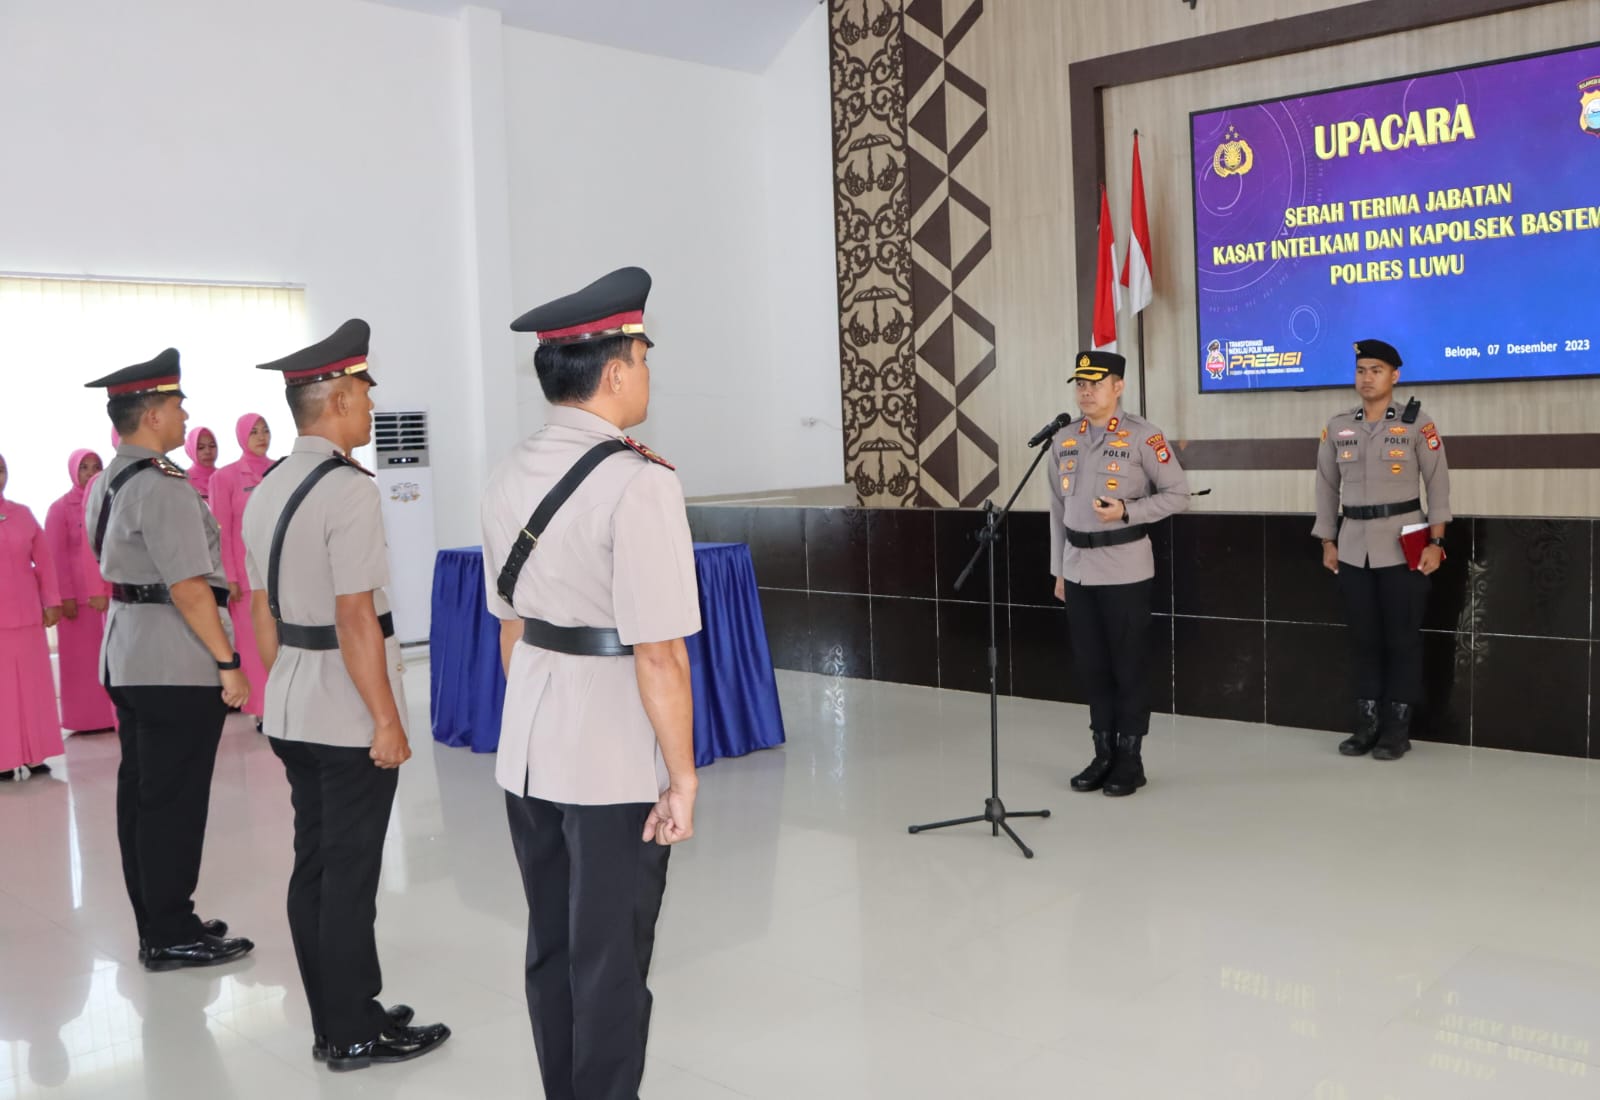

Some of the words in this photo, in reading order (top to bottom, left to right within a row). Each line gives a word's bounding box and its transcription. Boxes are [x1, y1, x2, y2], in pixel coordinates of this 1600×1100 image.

[1314, 103, 1475, 160] UPACARA
[1285, 203, 1344, 229] SERAH
[1349, 193, 1420, 221] TERIMA
[1425, 182, 1512, 213] JABATAN
[1213, 241, 1266, 266] KASAT
[1271, 231, 1360, 260] INTELKAM
[1365, 225, 1404, 251] DAN
[1409, 214, 1516, 246] KAPOLSEK
[1330, 258, 1403, 285] POLRES
[1409, 254, 1465, 279] LUWU
[1230, 352, 1302, 368] PRESISI
[1445, 346, 1481, 359] Belopa,
[1487, 344, 1500, 355] 07
[1507, 341, 1557, 354] Desember
[1564, 339, 1590, 351] 2023
[1384, 437, 1410, 446] POLRI
[1103, 450, 1130, 459] POLRI
